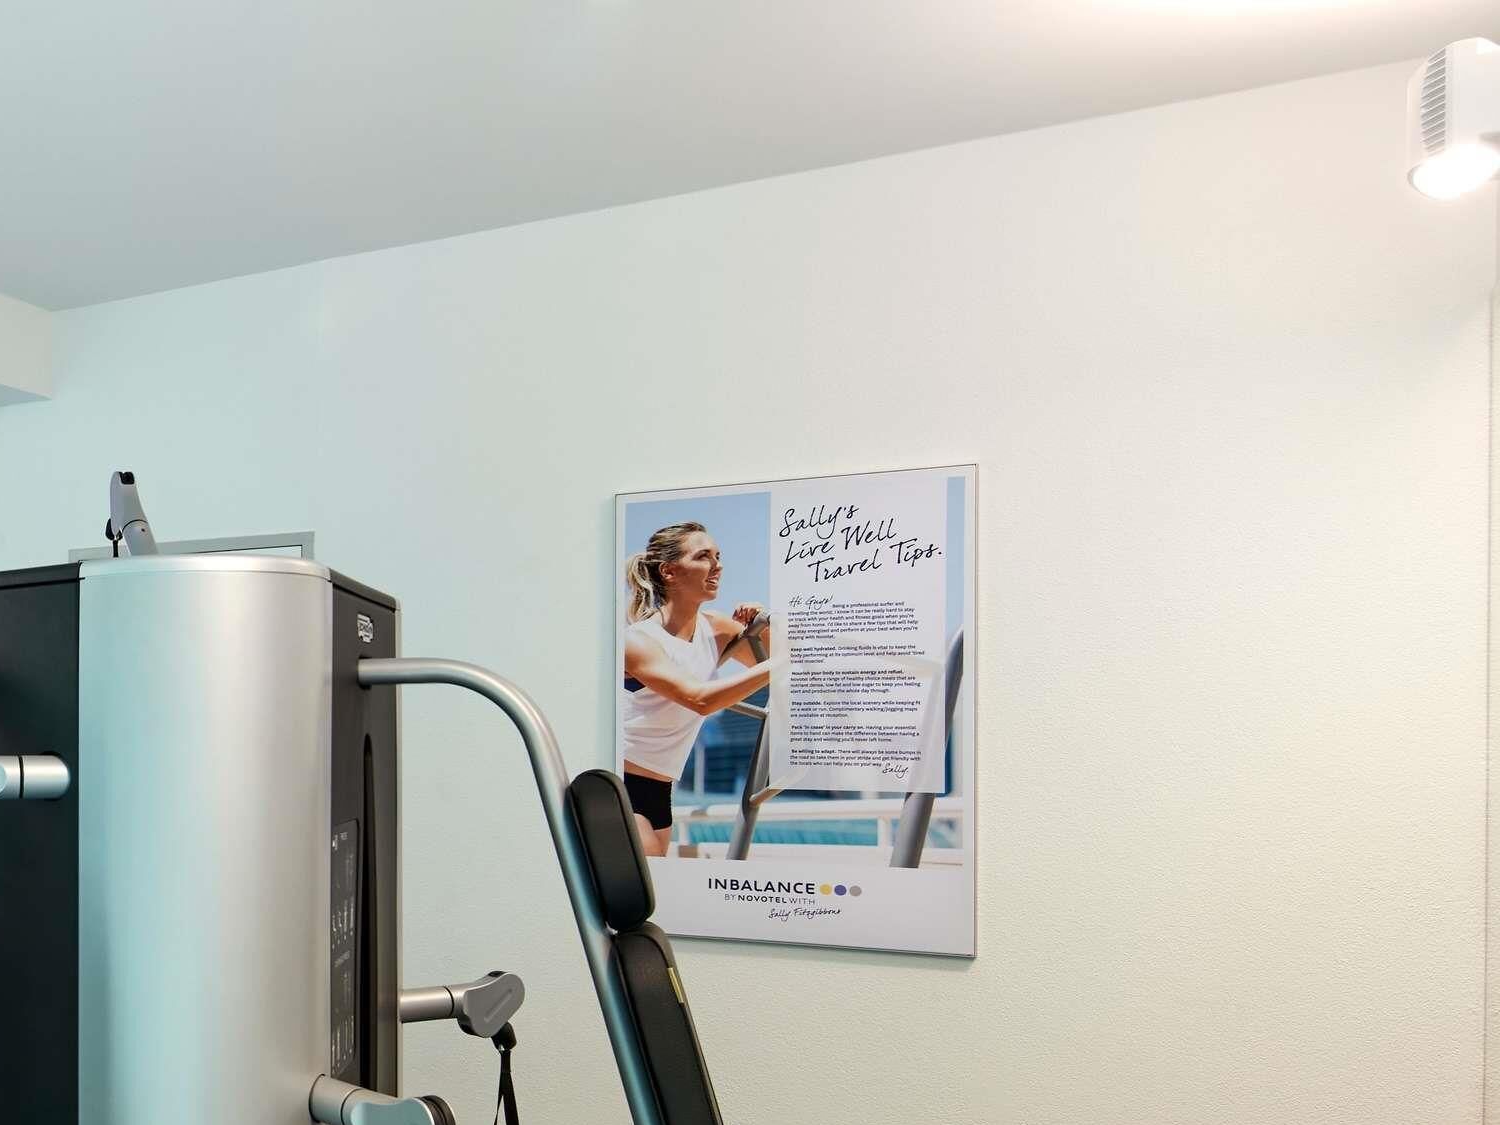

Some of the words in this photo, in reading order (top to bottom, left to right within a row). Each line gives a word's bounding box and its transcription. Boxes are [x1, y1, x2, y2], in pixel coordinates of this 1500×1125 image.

[779, 505, 859, 540] Sally's
[784, 541, 835, 564] Live
[840, 518, 897, 550] Well
[807, 548, 882, 582] Travel
[889, 538, 942, 567] Tips.
[789, 595, 803, 607] Hi
[708, 878, 816, 895] INBALANCE
[724, 893, 737, 901] BY
[737, 894, 788, 904] NOVOTEL
[789, 897, 816, 905] WITH
[768, 907, 791, 922] Sally
